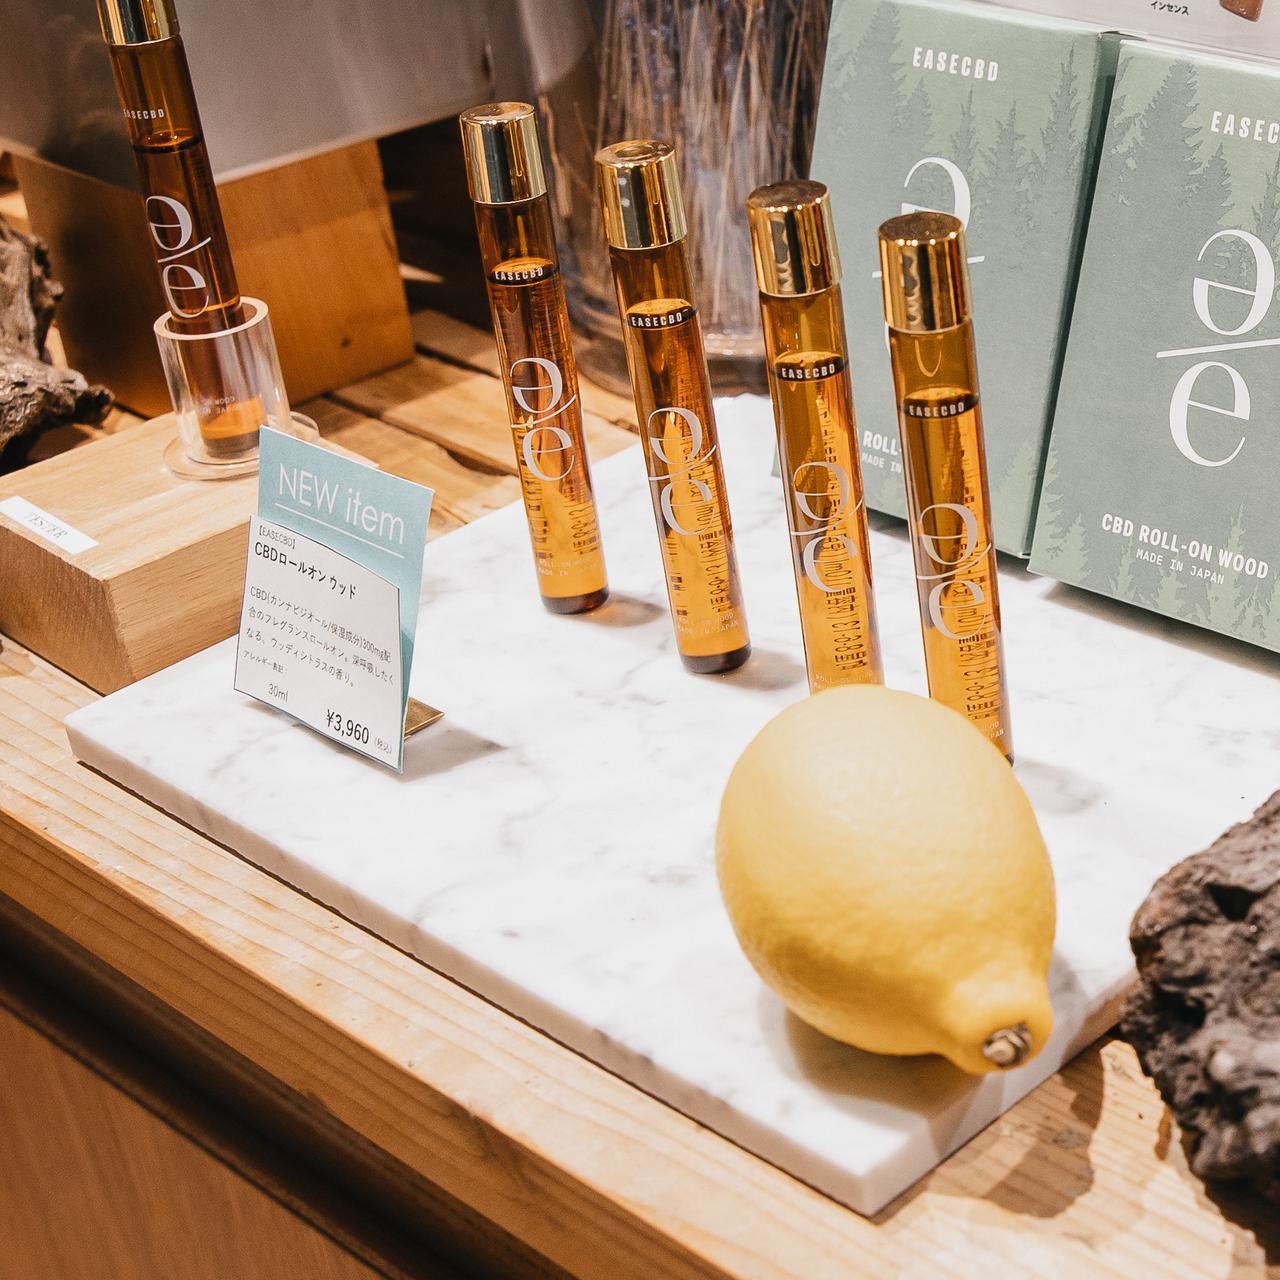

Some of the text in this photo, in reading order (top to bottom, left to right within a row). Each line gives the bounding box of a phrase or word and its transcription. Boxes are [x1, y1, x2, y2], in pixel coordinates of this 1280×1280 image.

[1150, 0, 1190, 16] インセンス
[912, 46, 1000, 82] EASECBD
[495, 267, 544, 281] EASECBD
[631, 311, 683, 328] EASECBD
[781, 363, 836, 380] EASECBD
[908, 401, 965, 418] EASECBD
[279, 462, 405, 545] NEW item
[1101, 512, 1270, 580] CBD ROLL-ON WOOD
[1136, 547, 1226, 586] MADE IN JAPAN
[329, 575, 358, 600] ウッド
[268, 682, 289, 703] 30ml
[326, 708, 370, 745] ¥3,960
